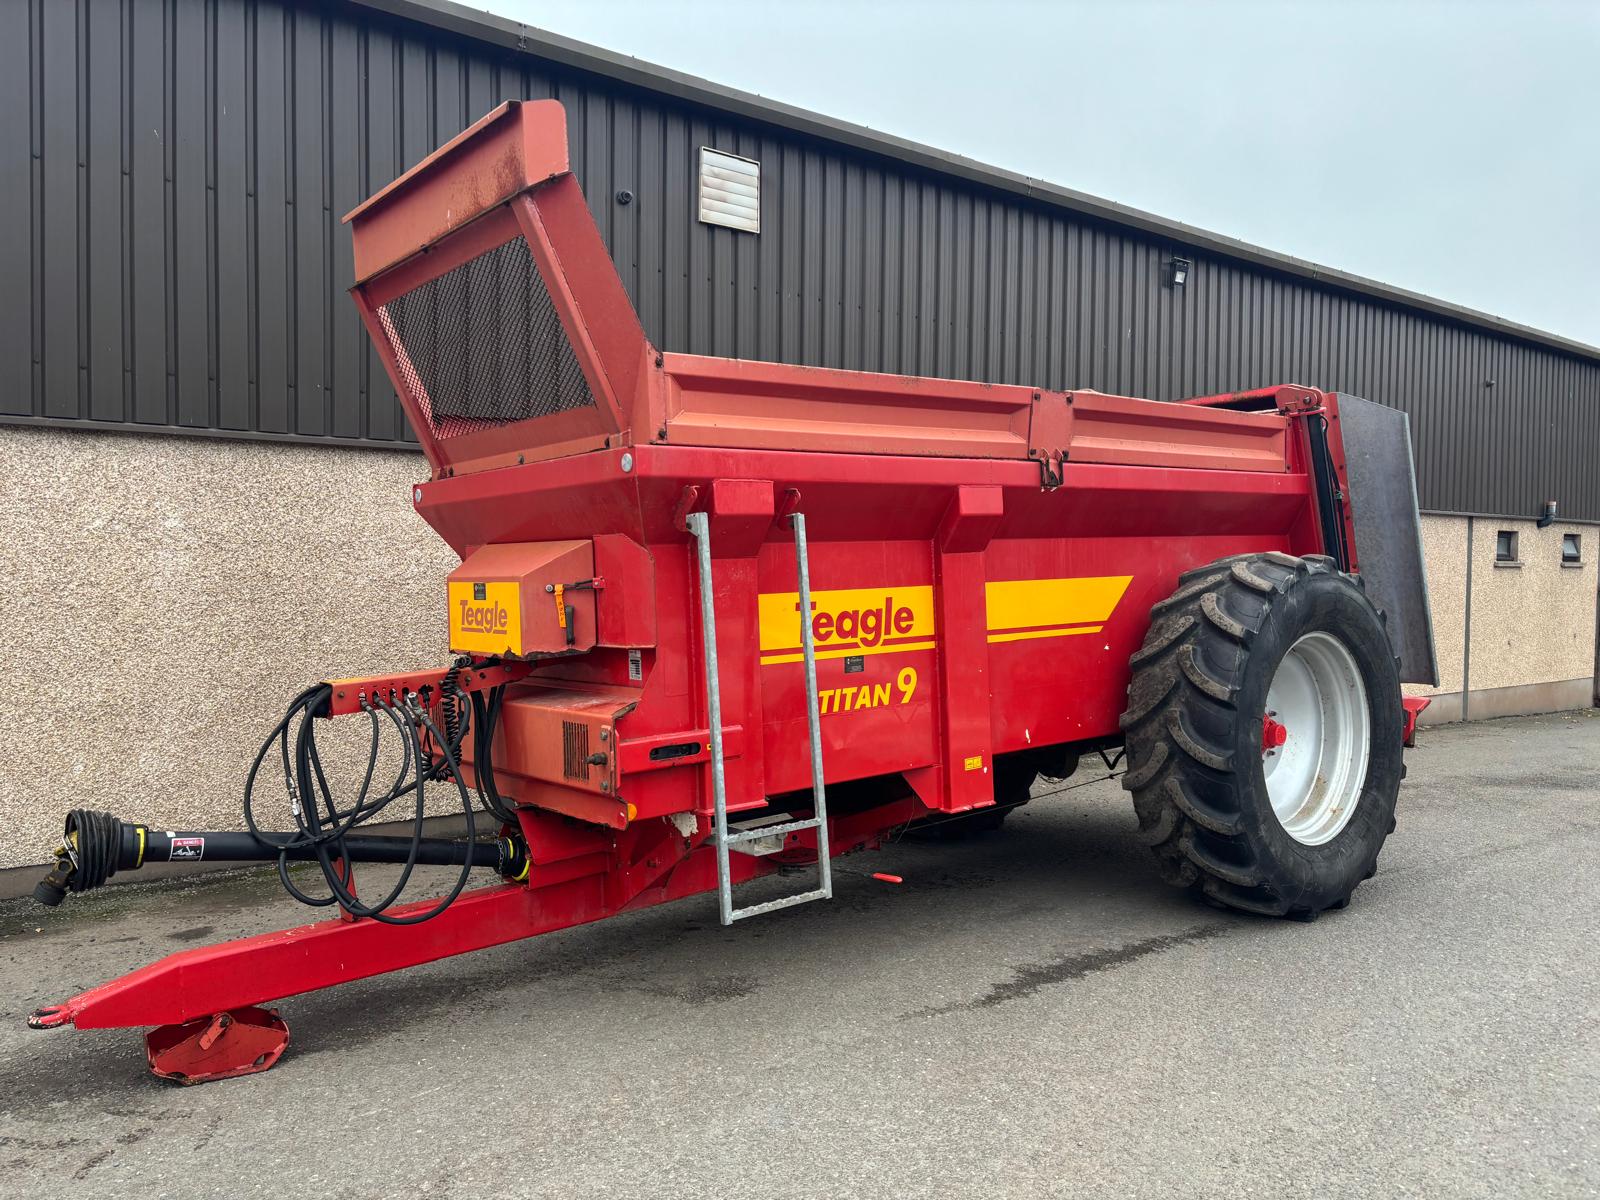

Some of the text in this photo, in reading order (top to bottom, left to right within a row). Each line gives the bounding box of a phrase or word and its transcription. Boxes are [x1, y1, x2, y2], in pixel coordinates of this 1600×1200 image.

[460, 600, 507, 633] Teagle
[818, 667, 918, 714] TITAN 9
